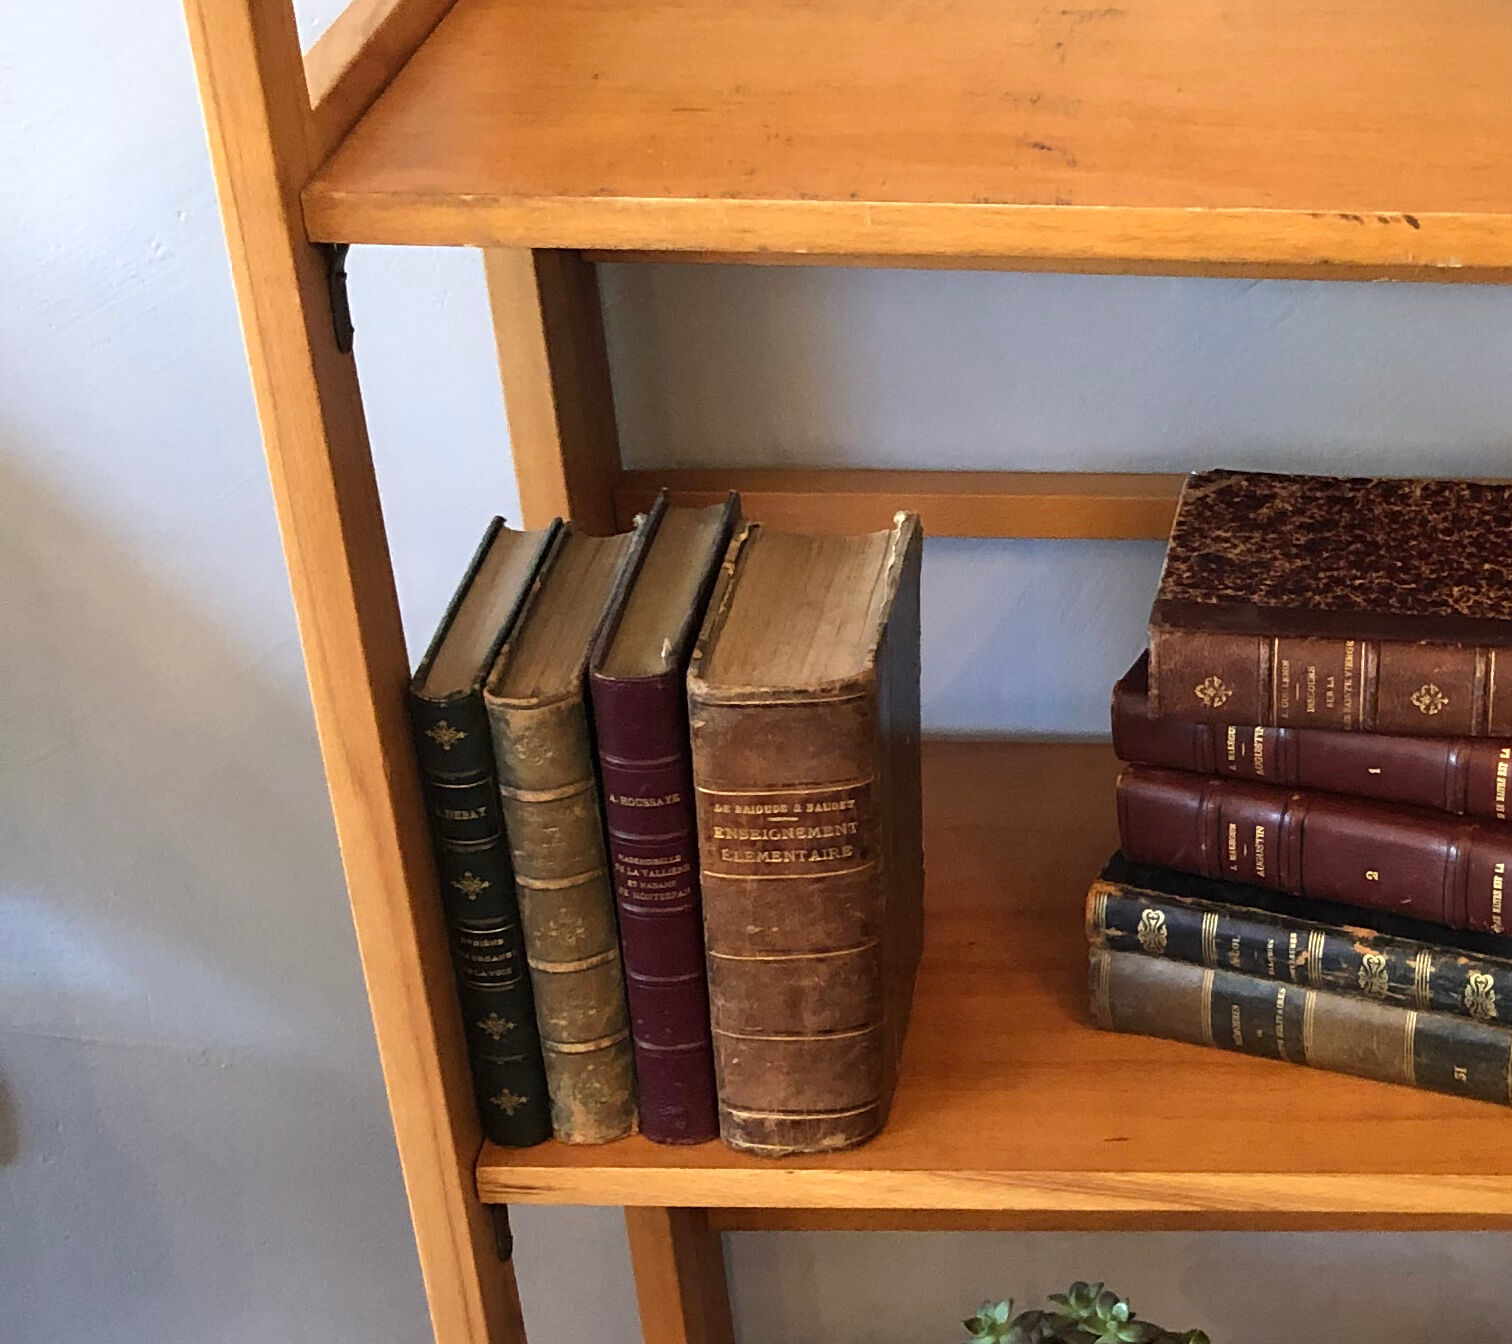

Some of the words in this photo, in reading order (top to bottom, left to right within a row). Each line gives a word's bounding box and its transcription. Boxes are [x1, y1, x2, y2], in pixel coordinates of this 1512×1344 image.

[1367, 767, 1381, 775] 1
[713, 821, 858, 841] ENSEIGNEMENT
[1255, 825, 1265, 877] AUGUSTIN
[626, 867, 640, 877] LA
[1366, 871, 1380, 881] 2
